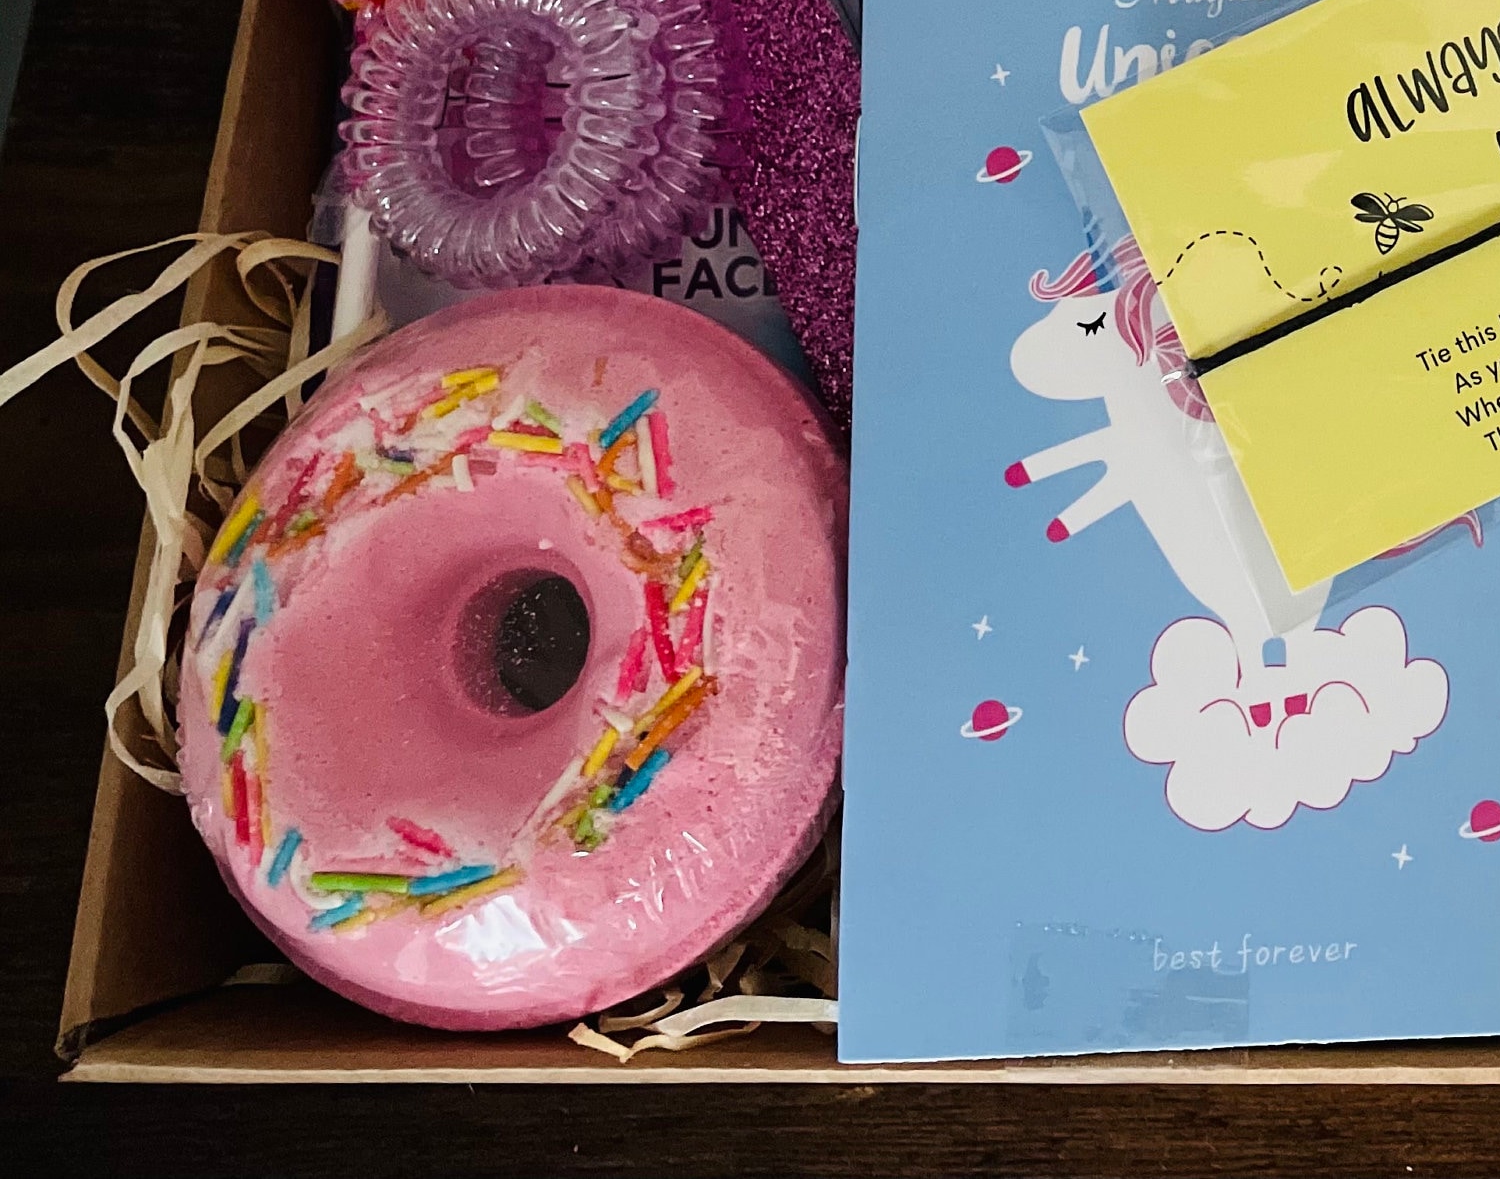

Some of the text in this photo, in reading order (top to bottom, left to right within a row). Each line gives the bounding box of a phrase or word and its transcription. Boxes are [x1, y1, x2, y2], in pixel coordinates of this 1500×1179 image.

[1416, 349, 1451, 373] Tie
[1455, 325, 1497, 355] this
[1455, 371, 1483, 394] As
[1153, 933, 1357, 974] best forever
